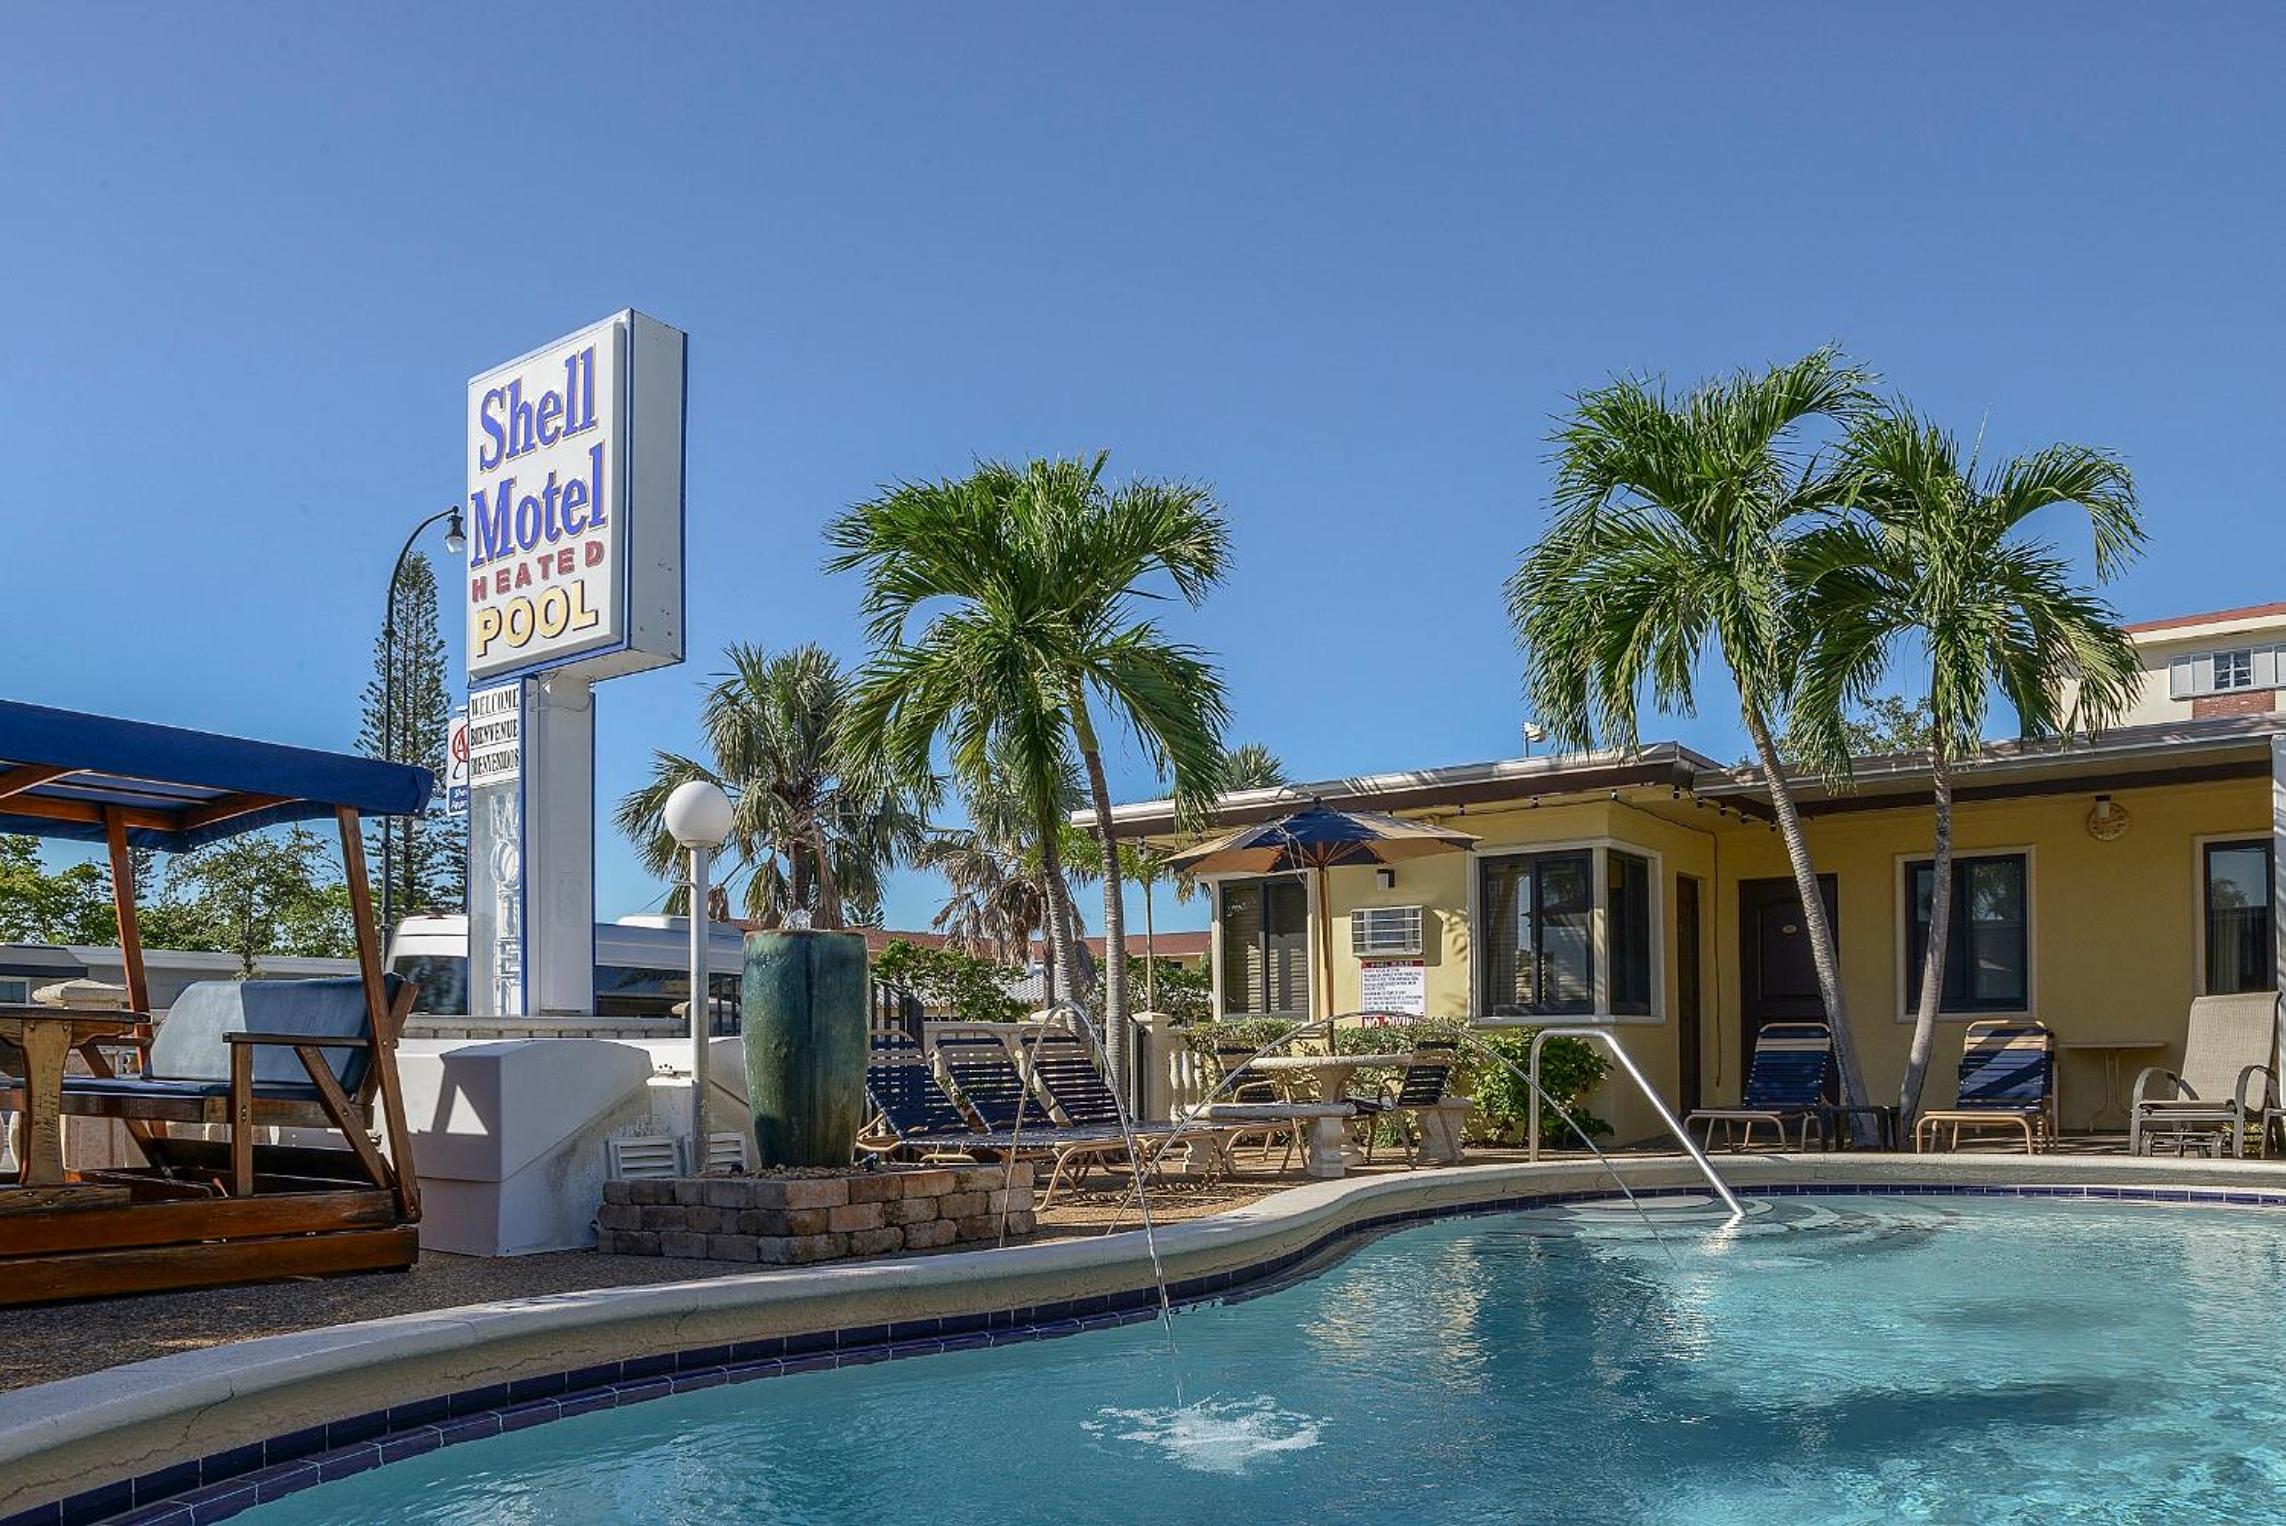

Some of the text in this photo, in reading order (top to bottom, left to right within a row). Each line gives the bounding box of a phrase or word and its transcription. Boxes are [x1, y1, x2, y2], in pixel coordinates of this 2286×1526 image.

[479, 343, 598, 473] Shell
[470, 440, 608, 569] Motel
[471, 540, 605, 602] HEATED
[475, 579, 599, 658] POOL
[470, 719, 518, 747] BIENVENUE
[471, 687, 519, 717] WELCOME
[470, 748, 519, 776] BIENVENIDOS
